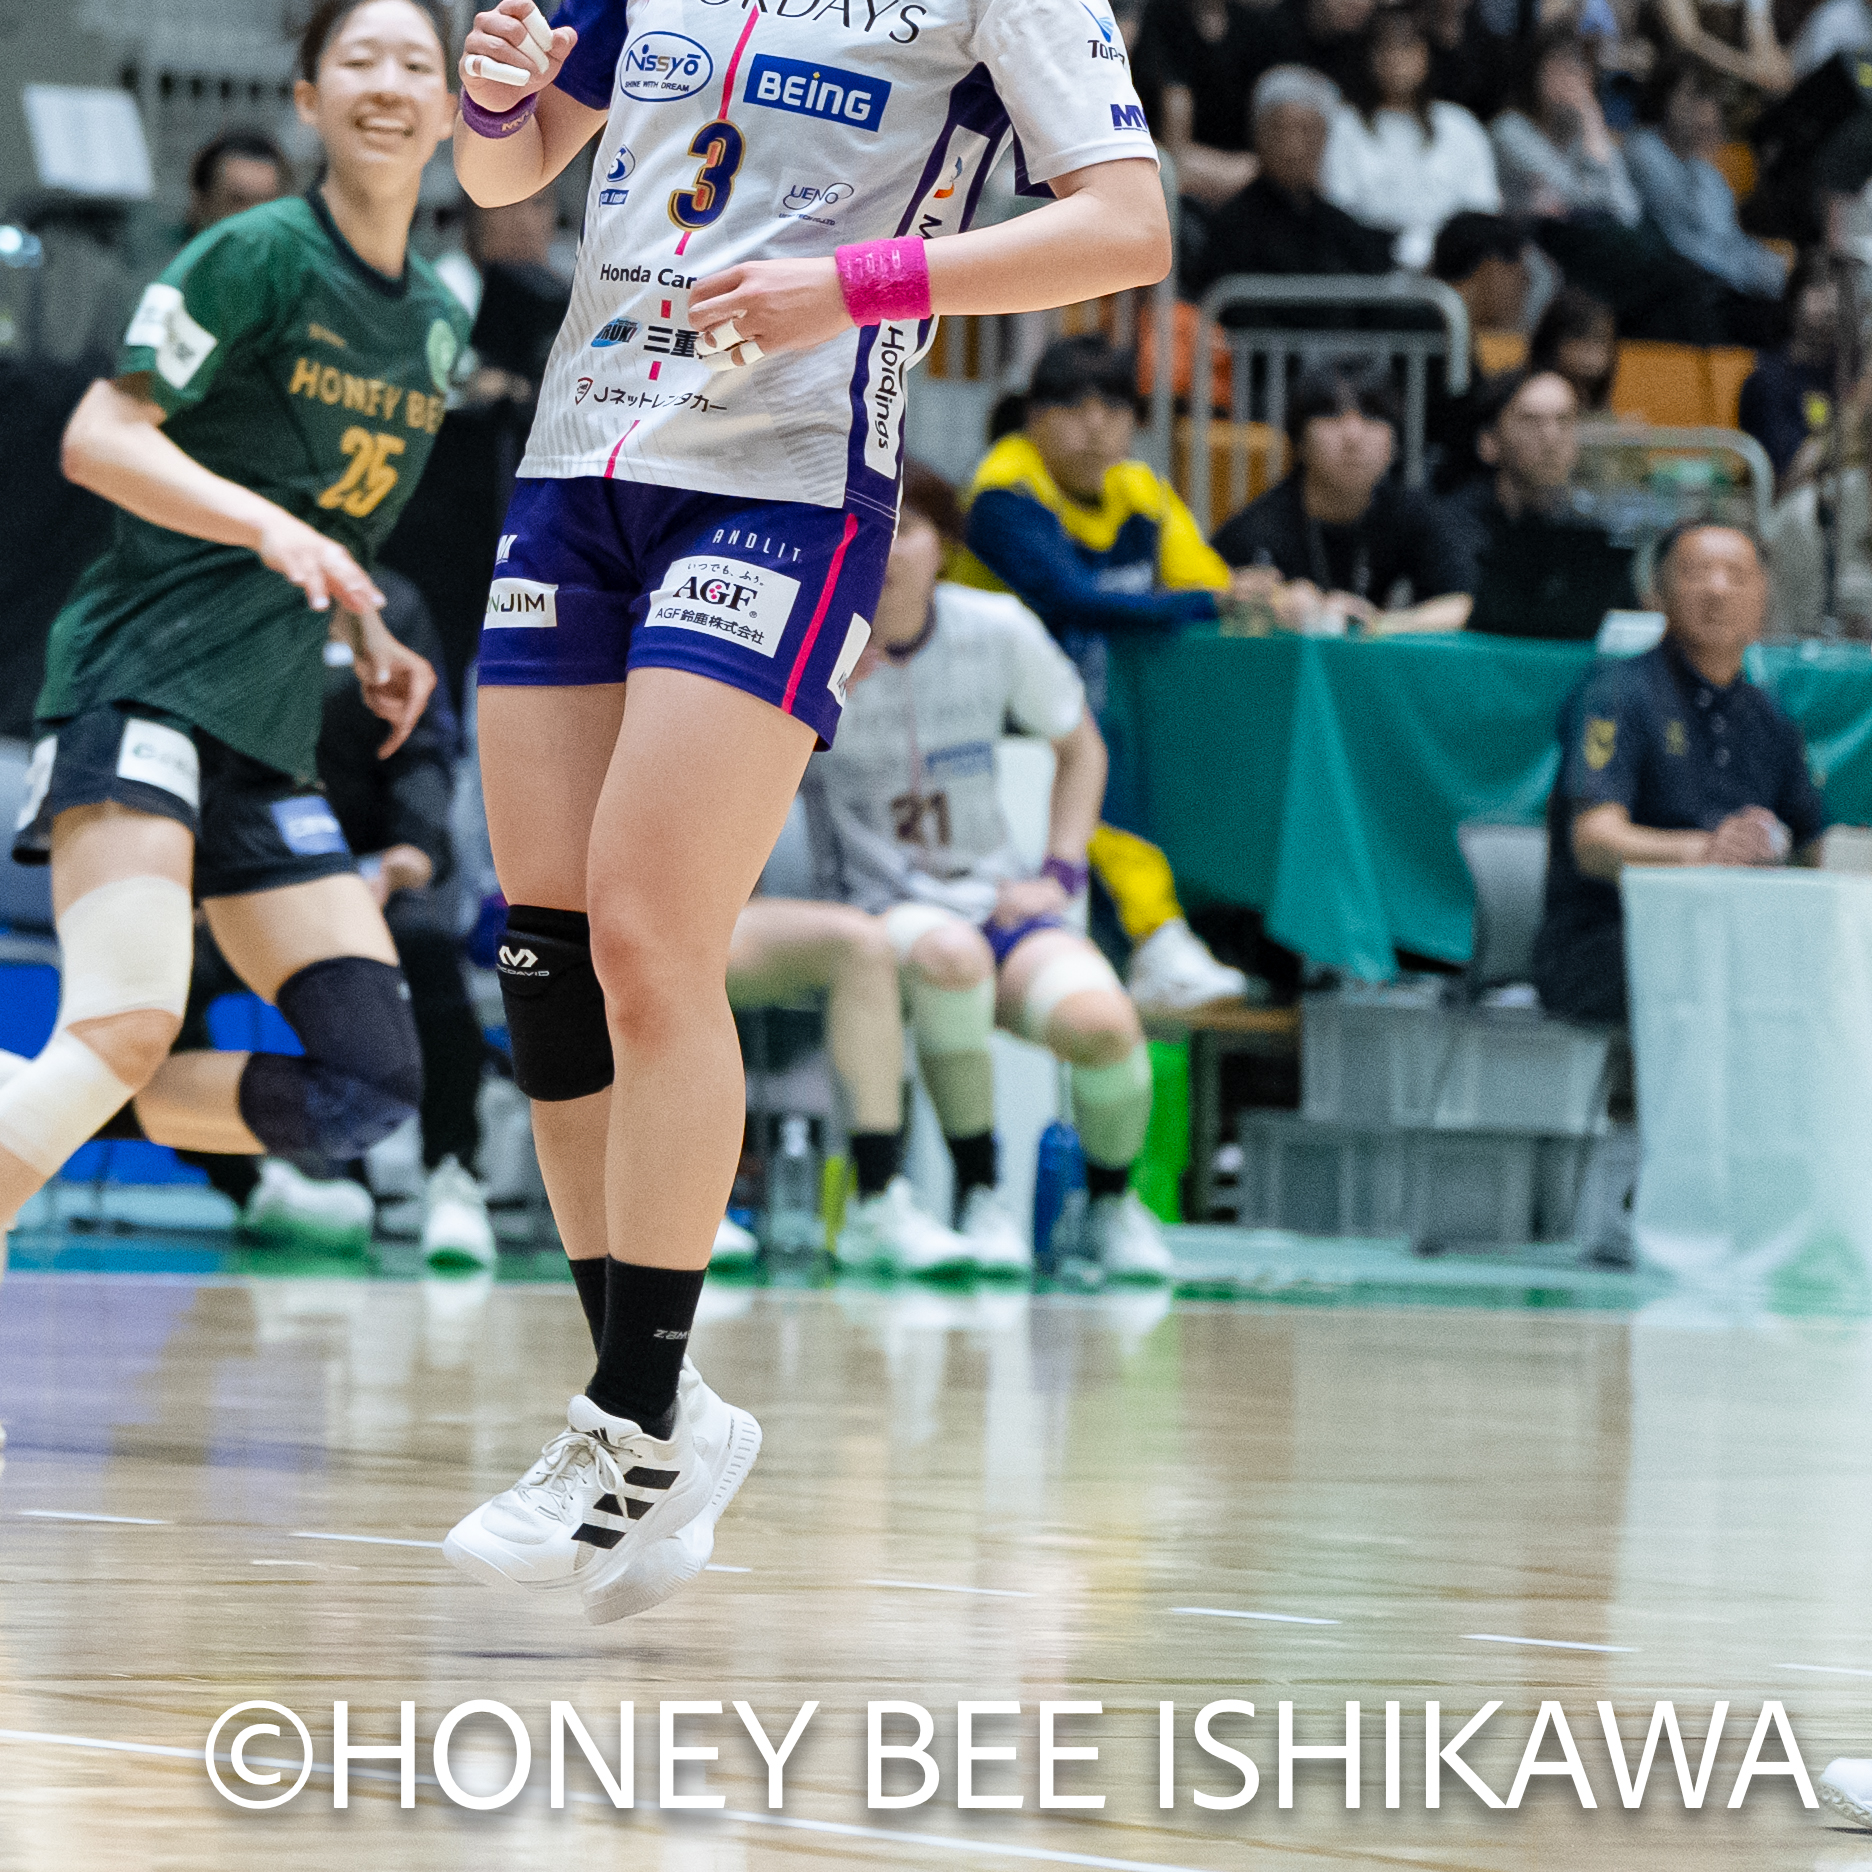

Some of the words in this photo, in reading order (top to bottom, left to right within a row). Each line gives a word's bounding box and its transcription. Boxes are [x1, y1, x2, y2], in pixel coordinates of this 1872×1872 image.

[661, 82, 690, 92] DREAM
[667, 118, 746, 232] 3
[600, 264, 651, 282] Honda
[643, 325, 702, 359] 三重
[877, 326, 904, 450] Holdings
[318, 425, 406, 518] 25
[712, 529, 801, 562] ANDLIT
[655, 608, 765, 645] AGF鈴鹿株式会社
[890, 791, 951, 847] 21
